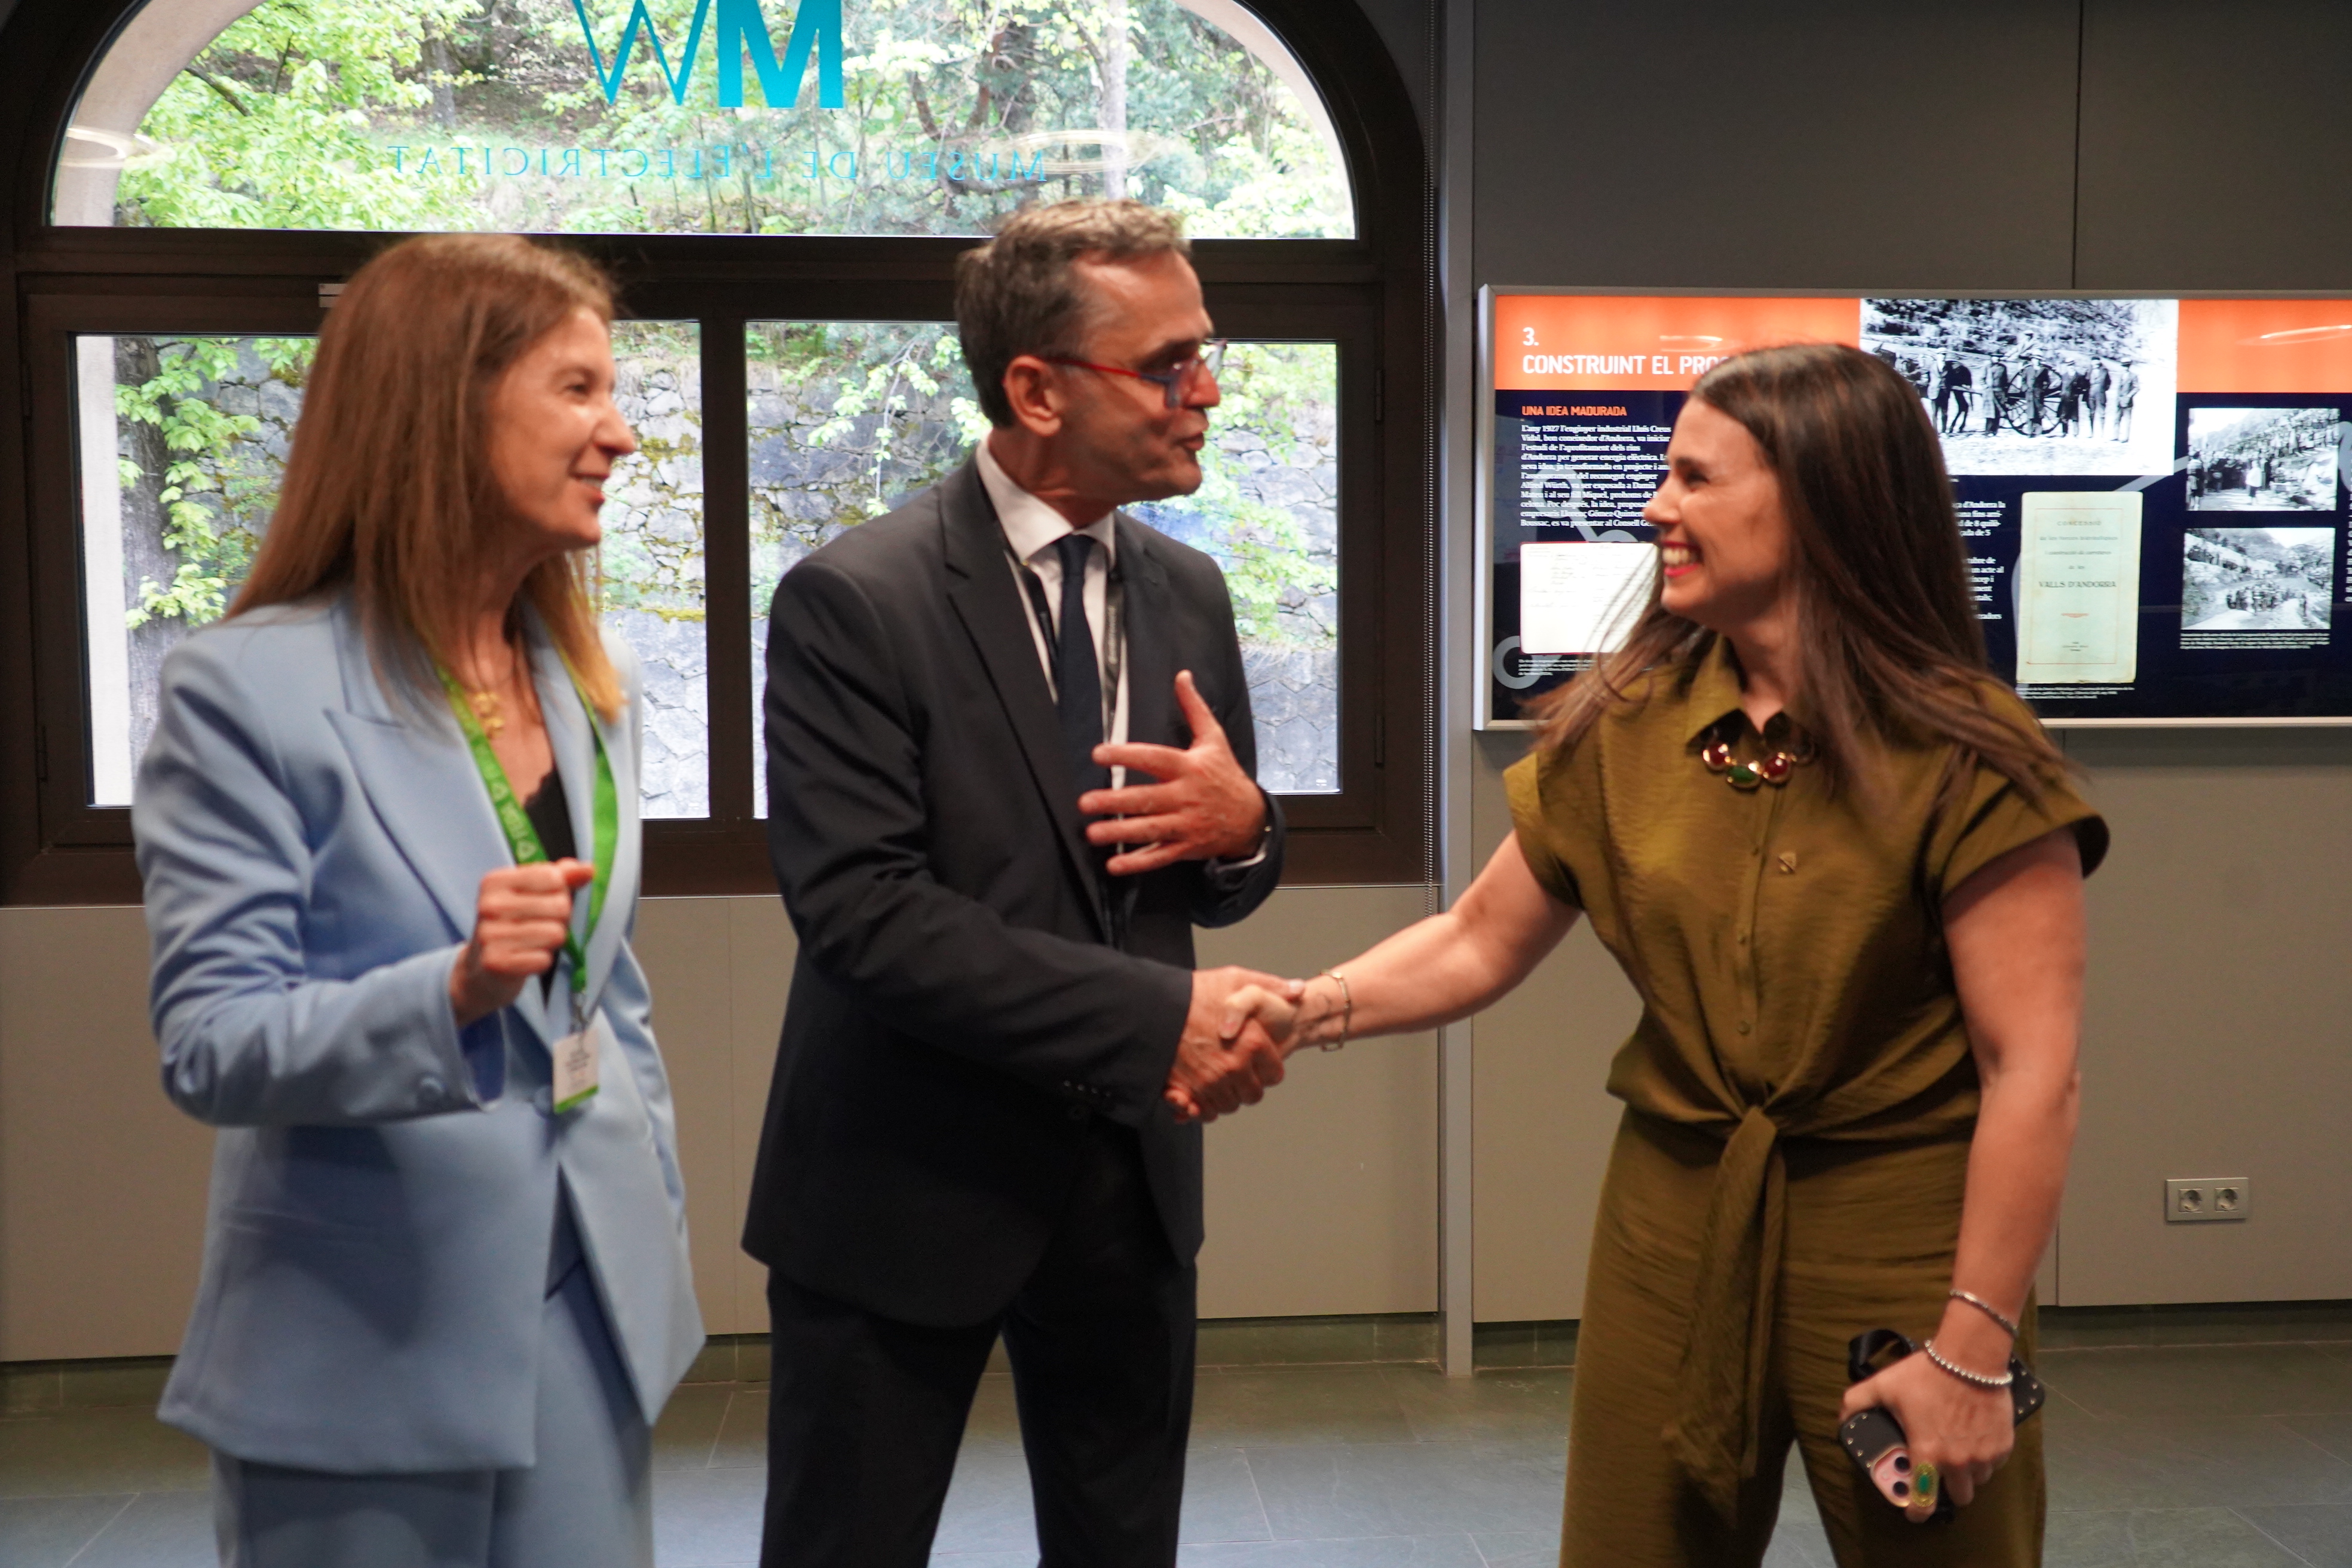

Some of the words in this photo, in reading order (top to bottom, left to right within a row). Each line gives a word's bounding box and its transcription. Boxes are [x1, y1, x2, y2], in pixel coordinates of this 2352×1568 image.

[1523, 327, 1539, 346] 3.
[1523, 355, 1647, 375] CONSTRUINT
[1652, 356, 1674, 375] EL
[1679, 356, 1729, 375] PRO
[1521, 406, 1544, 415] UNA
[1546, 406, 1569, 415] IDEA
[1570, 406, 1627, 416] MADURADA
